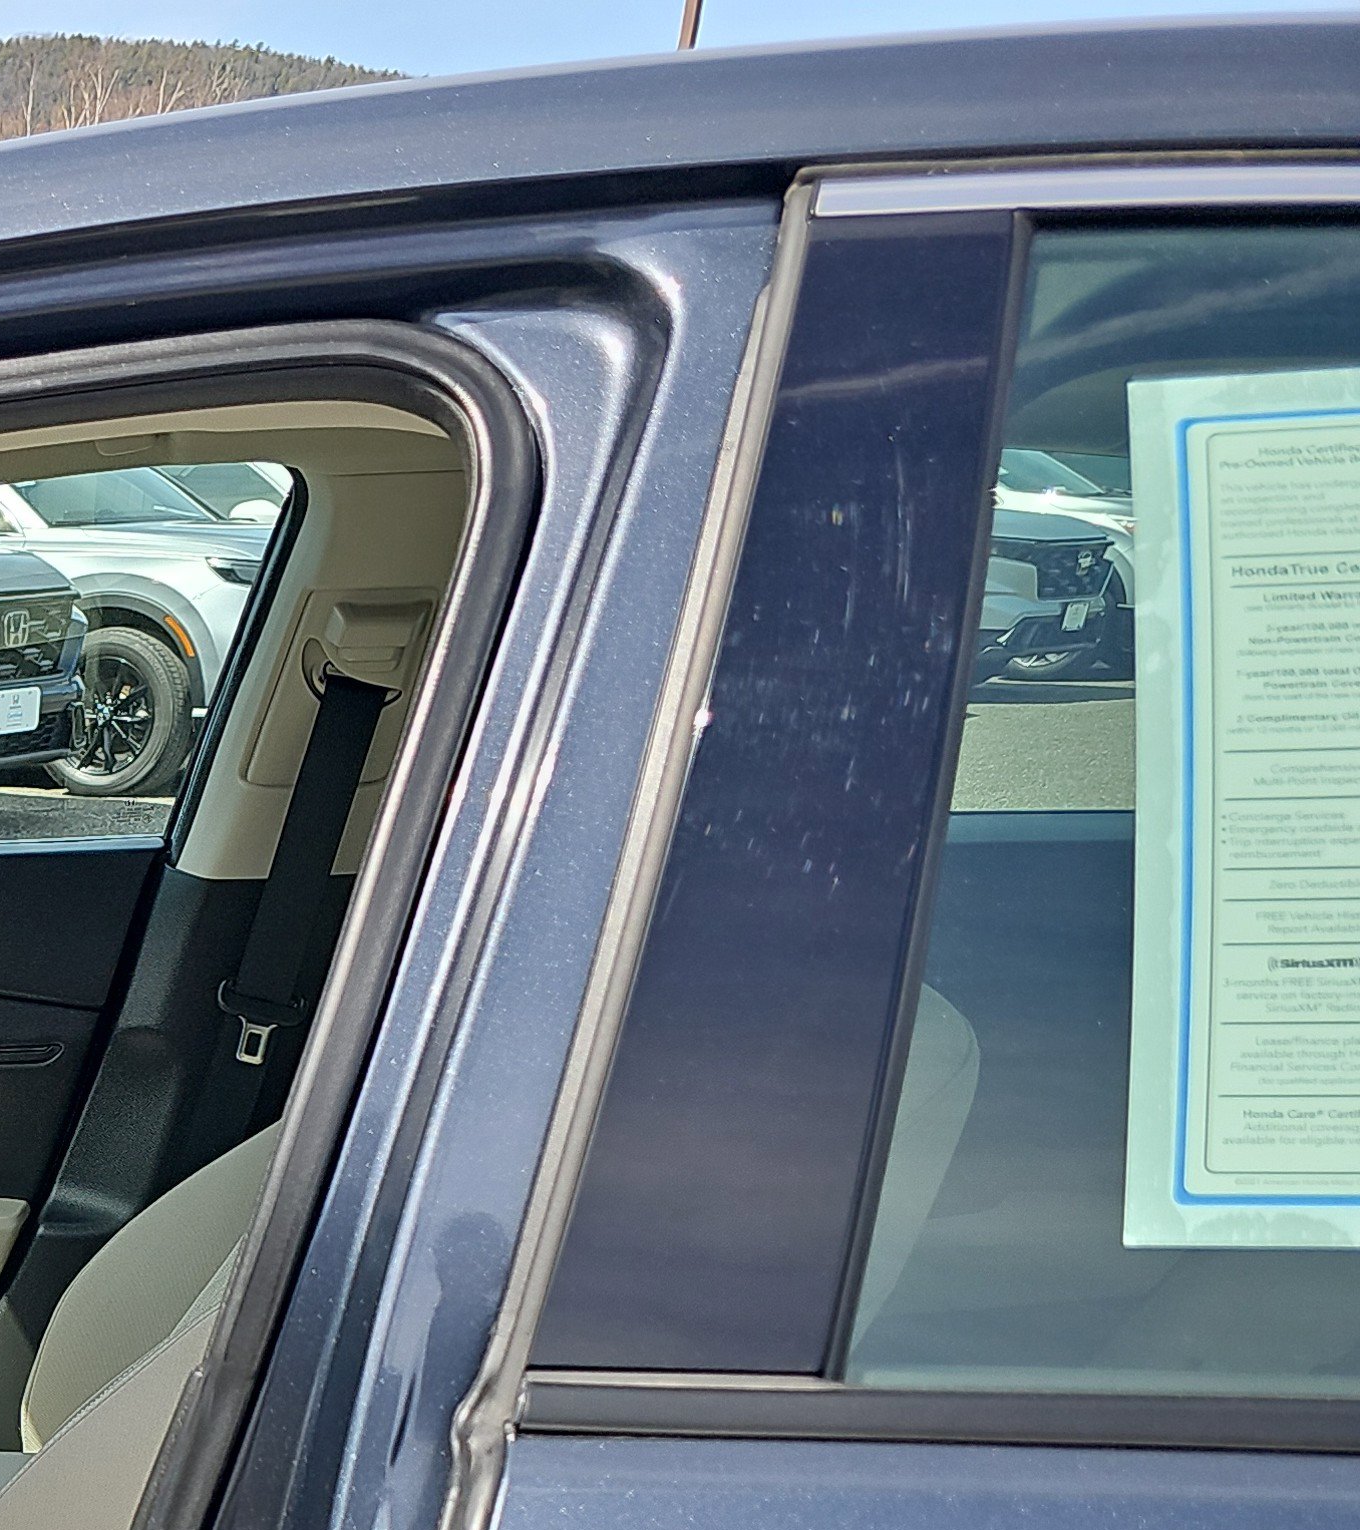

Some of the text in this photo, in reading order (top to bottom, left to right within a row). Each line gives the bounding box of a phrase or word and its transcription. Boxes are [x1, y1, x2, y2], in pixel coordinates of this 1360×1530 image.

[1231, 563, 1329, 577] HondaTrue
[1263, 591, 1316, 602] Limited
[1247, 714, 1337, 723] Complimentary
[1242, 1109, 1283, 1118] Honda
